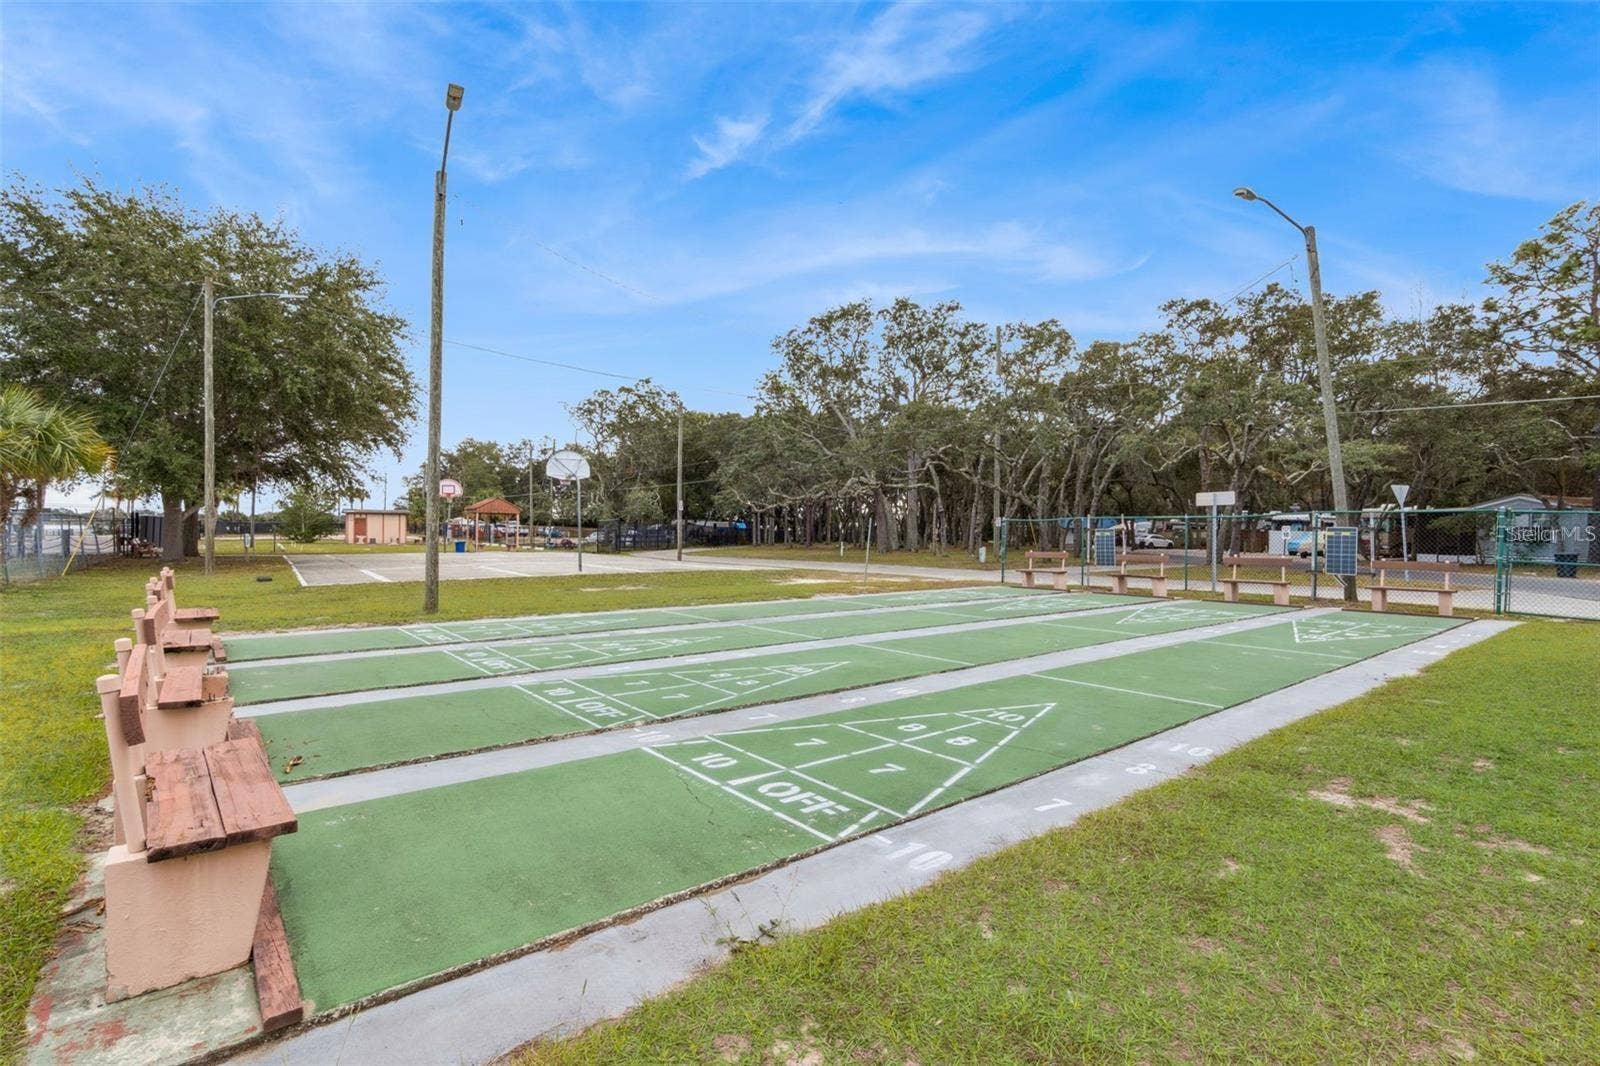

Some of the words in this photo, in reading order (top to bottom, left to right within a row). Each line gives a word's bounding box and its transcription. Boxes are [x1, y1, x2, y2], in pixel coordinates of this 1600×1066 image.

[986, 710, 1025, 722] 10
[897, 723, 927, 733] 8
[945, 736, 978, 747] 8
[1169, 743, 1214, 758] 10
[868, 763, 907, 775] 7
[1125, 763, 1157, 775] 8
[691, 752, 738, 769] 10
[758, 781, 851, 816] OFF
[1033, 798, 1073, 812] 7
